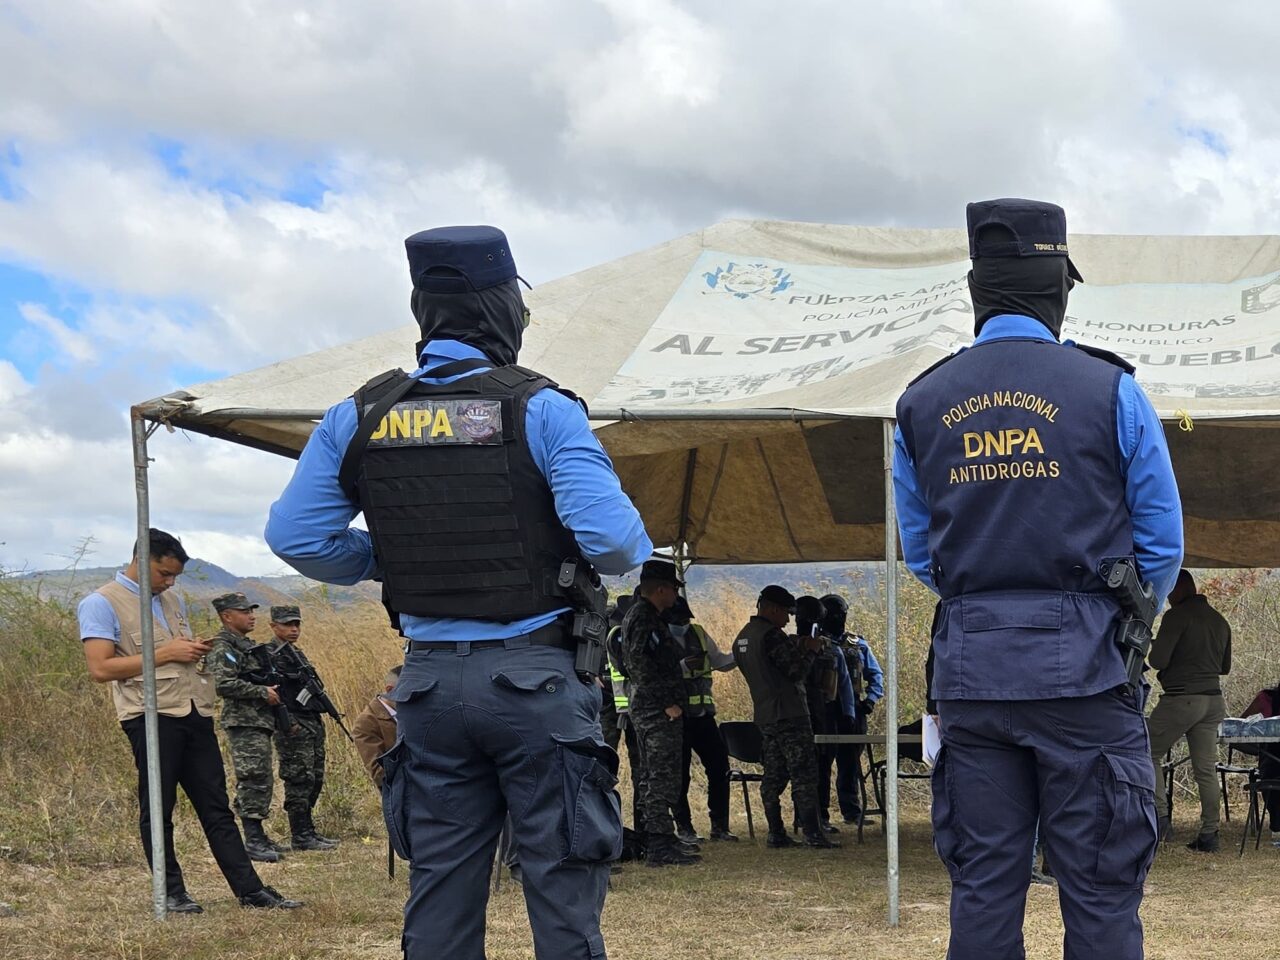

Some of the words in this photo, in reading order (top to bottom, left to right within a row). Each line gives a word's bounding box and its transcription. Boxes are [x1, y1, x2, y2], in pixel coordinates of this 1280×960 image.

[650, 333, 723, 356] AL
[736, 299, 974, 356] SERVICIO
[1085, 314, 1236, 332] HONDURAS
[942, 393, 992, 429] POLICIA
[993, 390, 1060, 423] NACIONAL
[963, 427, 1045, 459] DNPA
[949, 460, 1060, 485] ANTIDROGAS
